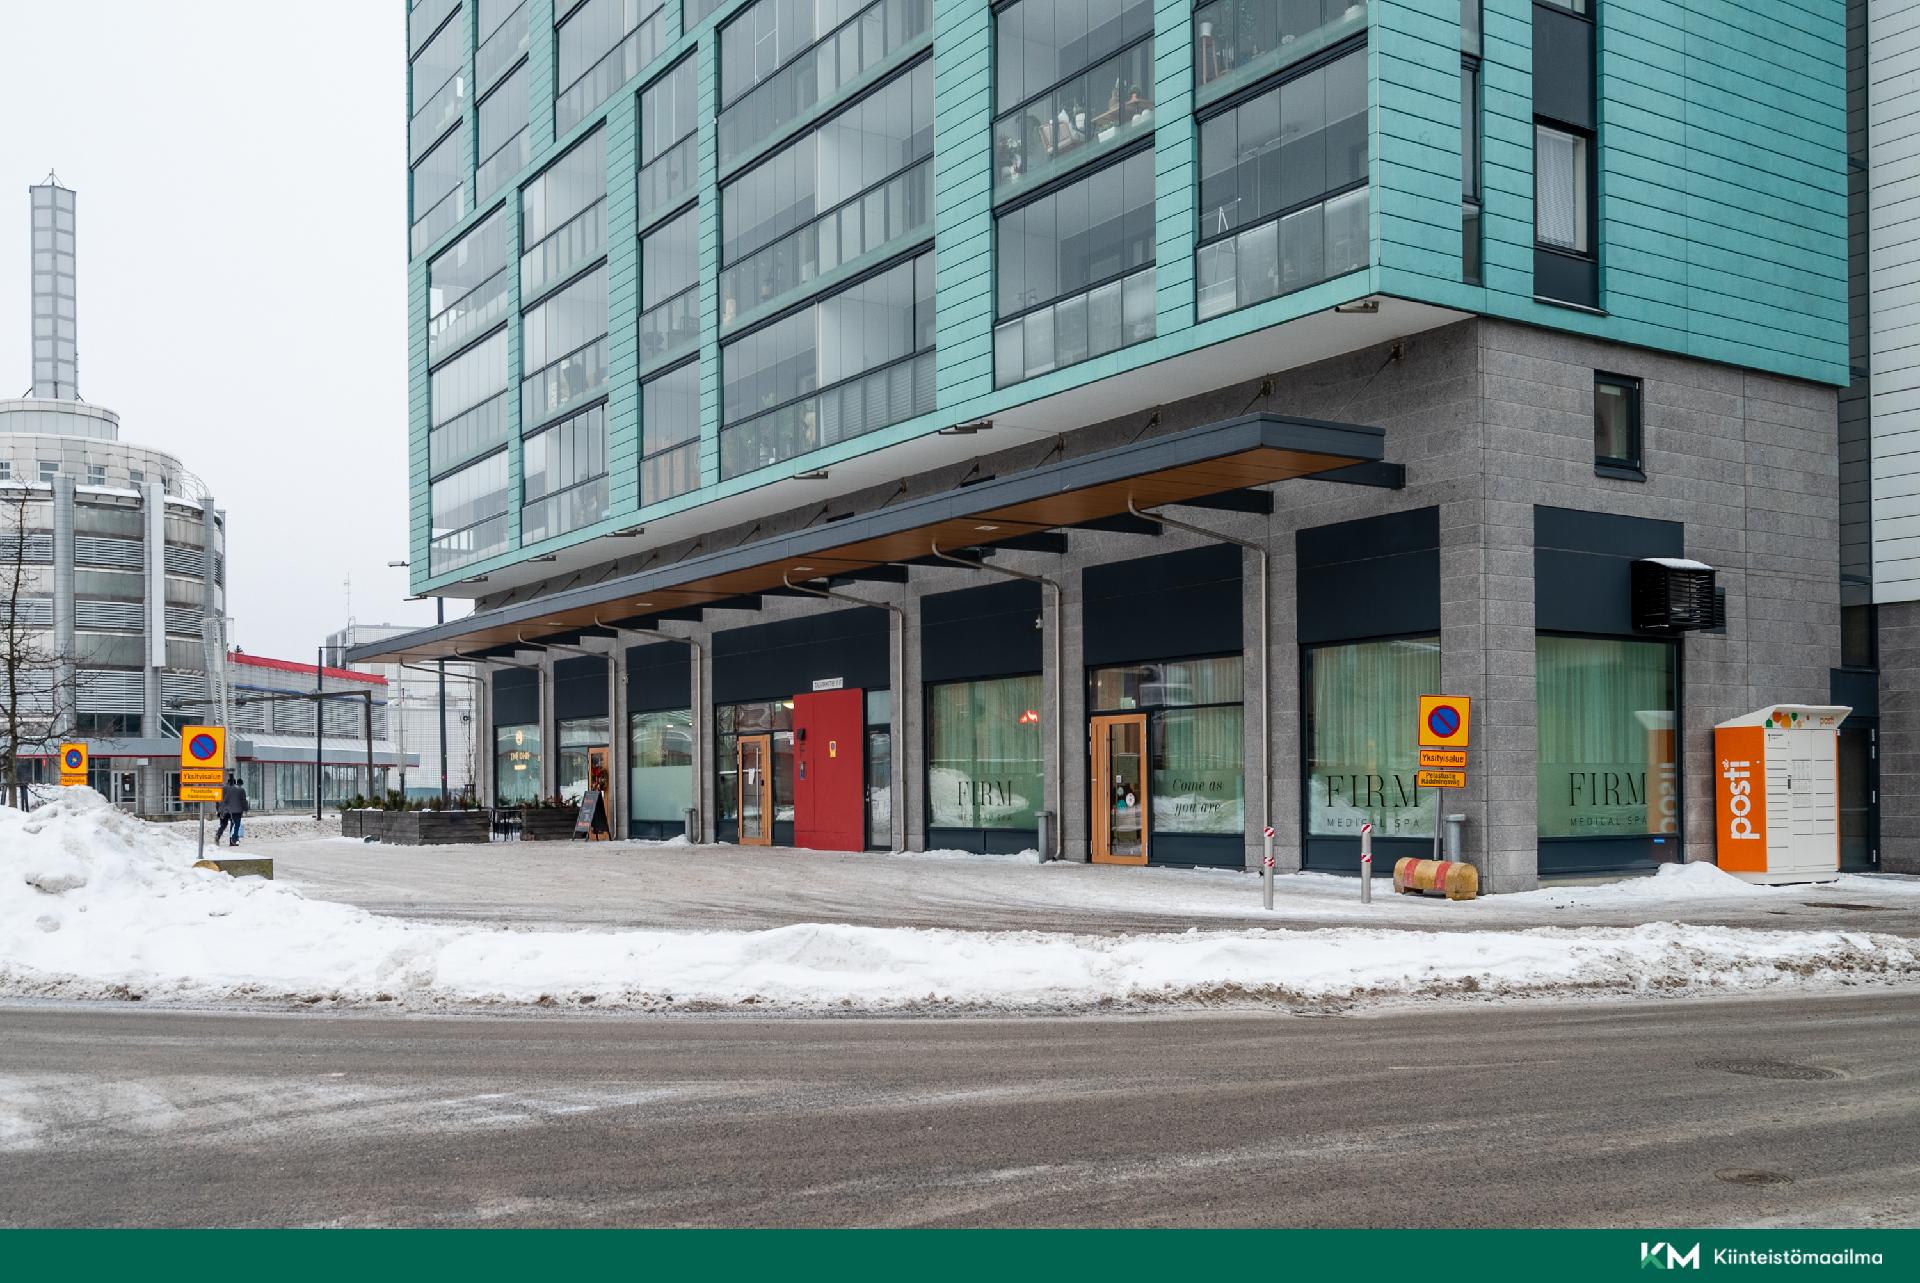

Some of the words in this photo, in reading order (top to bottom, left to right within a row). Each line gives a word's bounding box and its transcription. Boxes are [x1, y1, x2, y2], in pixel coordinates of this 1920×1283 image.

[1422, 754, 1465, 763] Yksityisalue
[1172, 778, 1205, 791] Come
[1209, 780, 1223, 791] as
[1325, 774, 1420, 807] FIRM
[1568, 772, 1648, 806] FIRM
[957, 780, 1013, 806] FIRM
[1722, 759, 1760, 840] posti
[1174, 803, 1197, 816] you
[1200, 803, 1220, 813] are
[1394, 818, 1420, 828] SPA
[1570, 816, 1620, 827] MEDICAL
[1627, 815, 1648, 825] SPA
